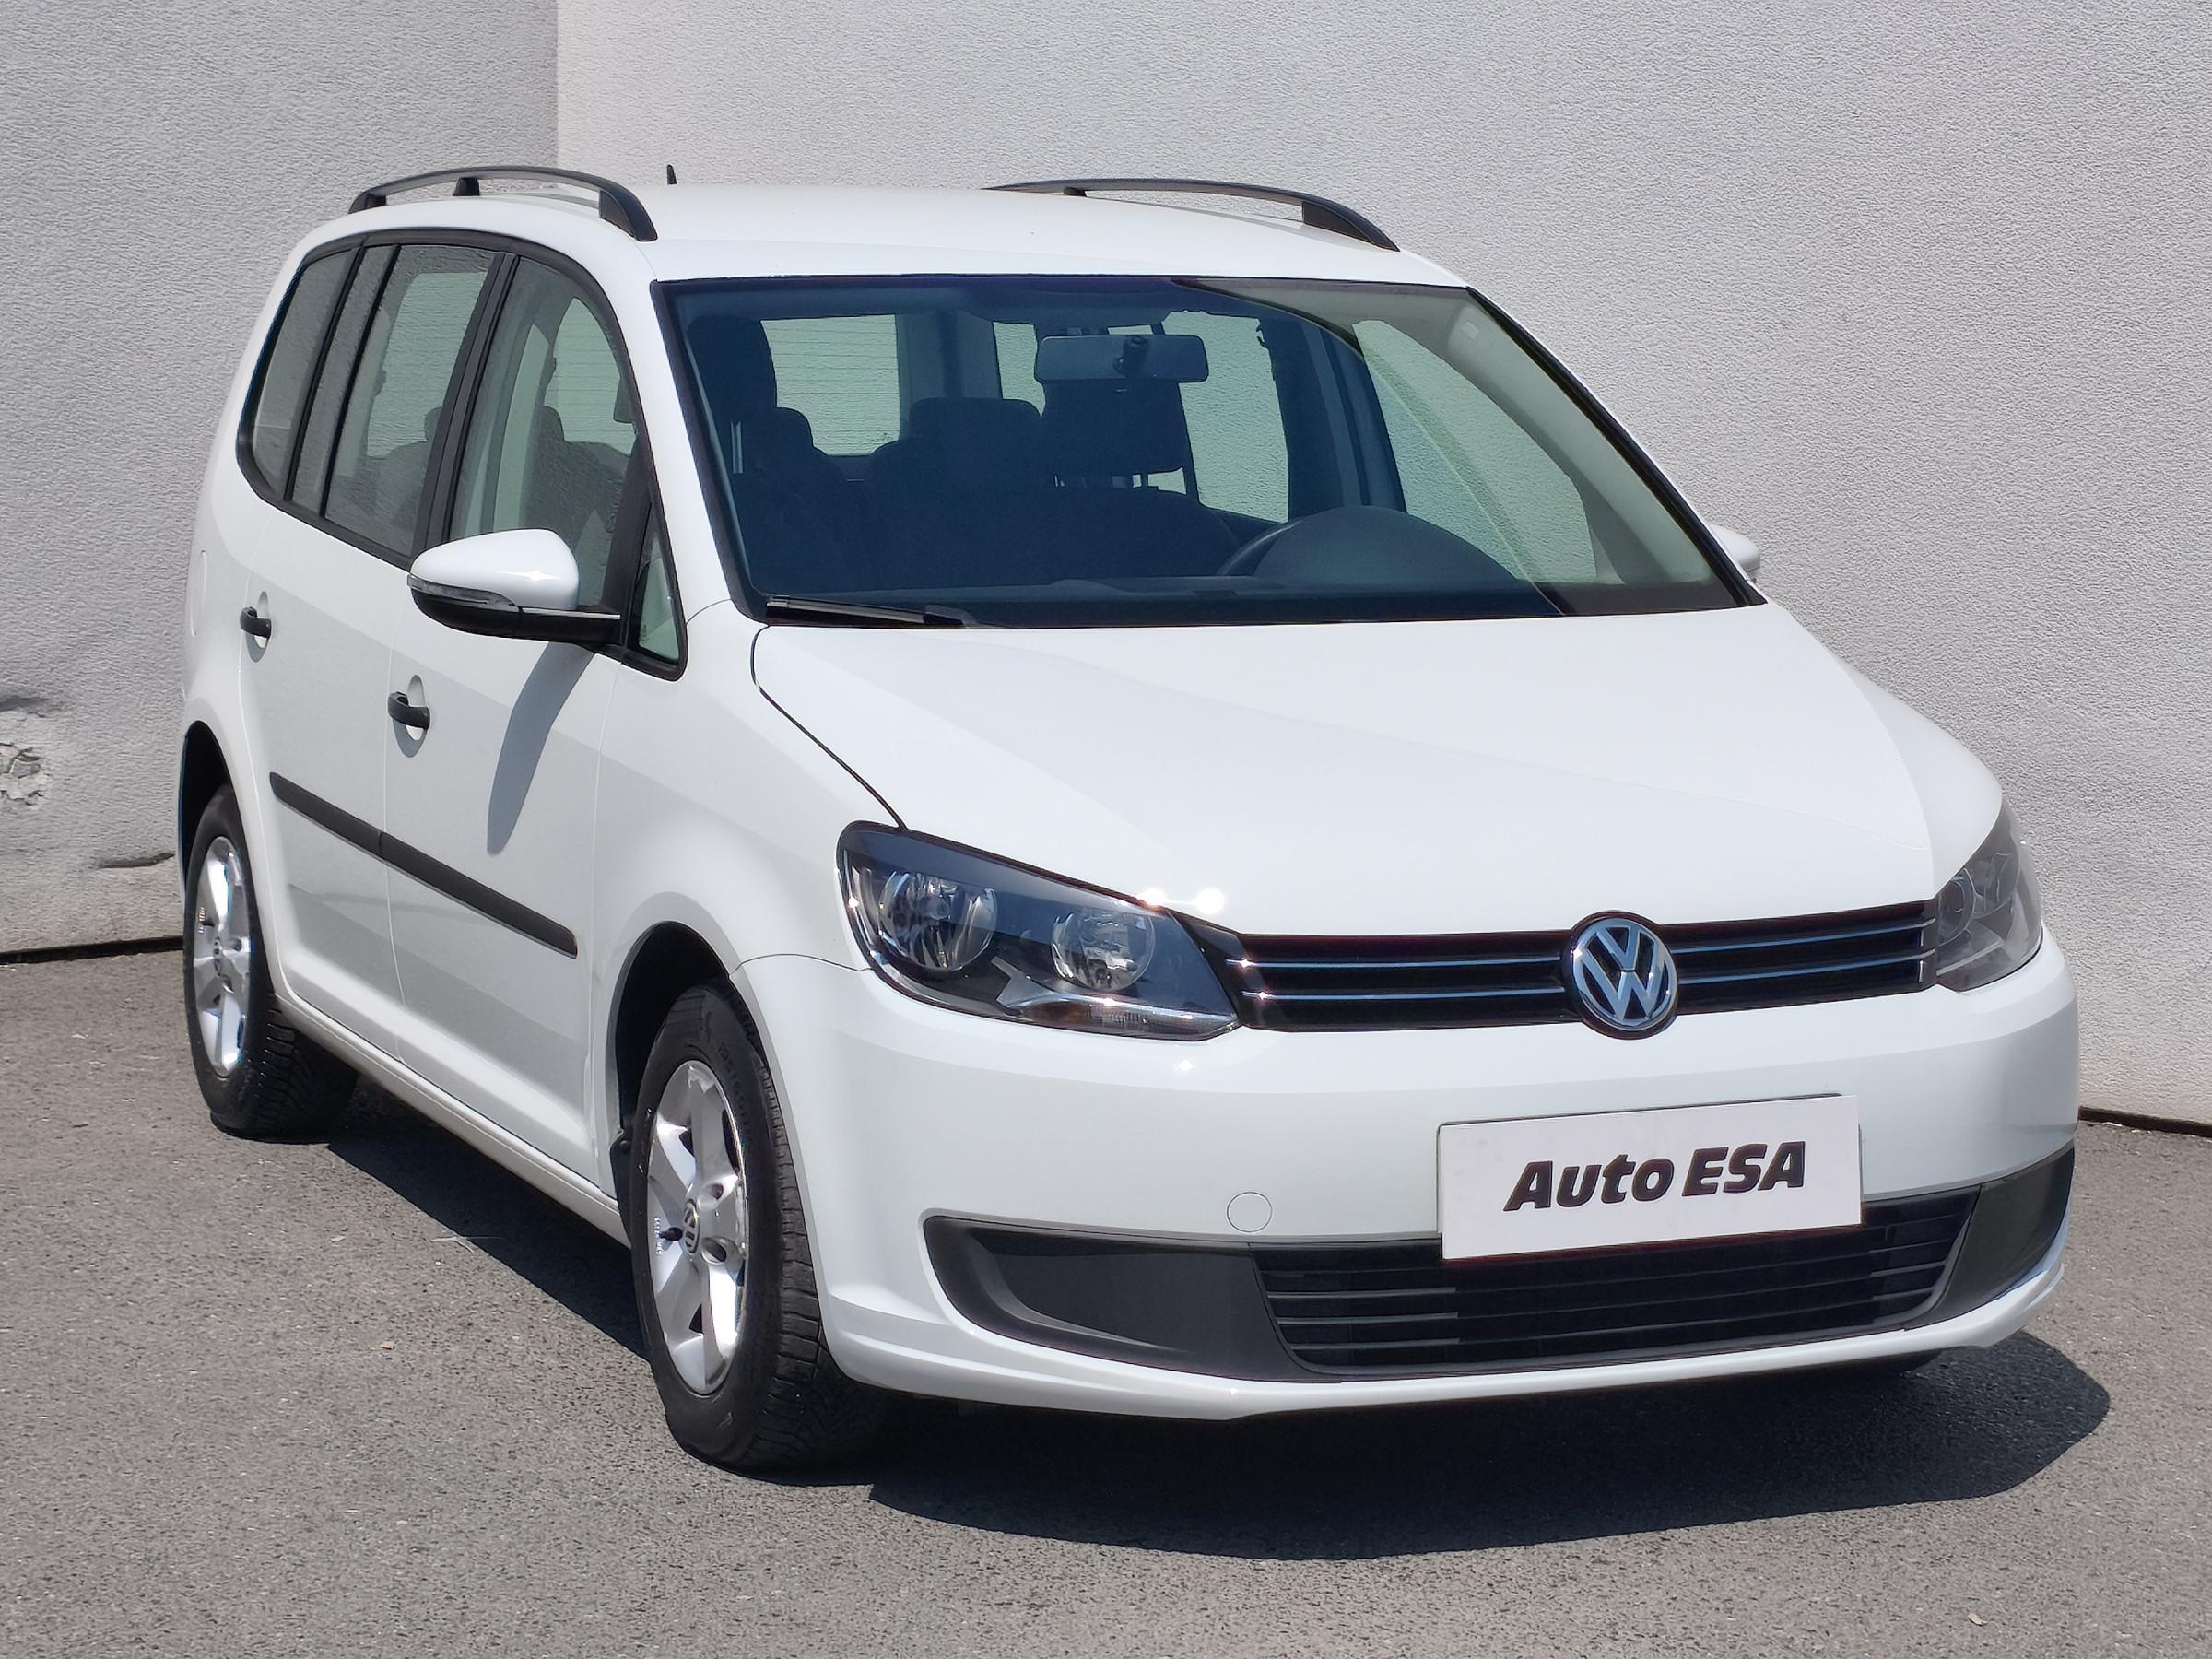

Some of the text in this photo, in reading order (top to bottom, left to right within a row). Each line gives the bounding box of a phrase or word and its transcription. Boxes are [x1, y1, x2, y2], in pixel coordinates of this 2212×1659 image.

[1573, 918, 1677, 1030] VW
[1502, 1140, 1806, 1212] Auto ESA
